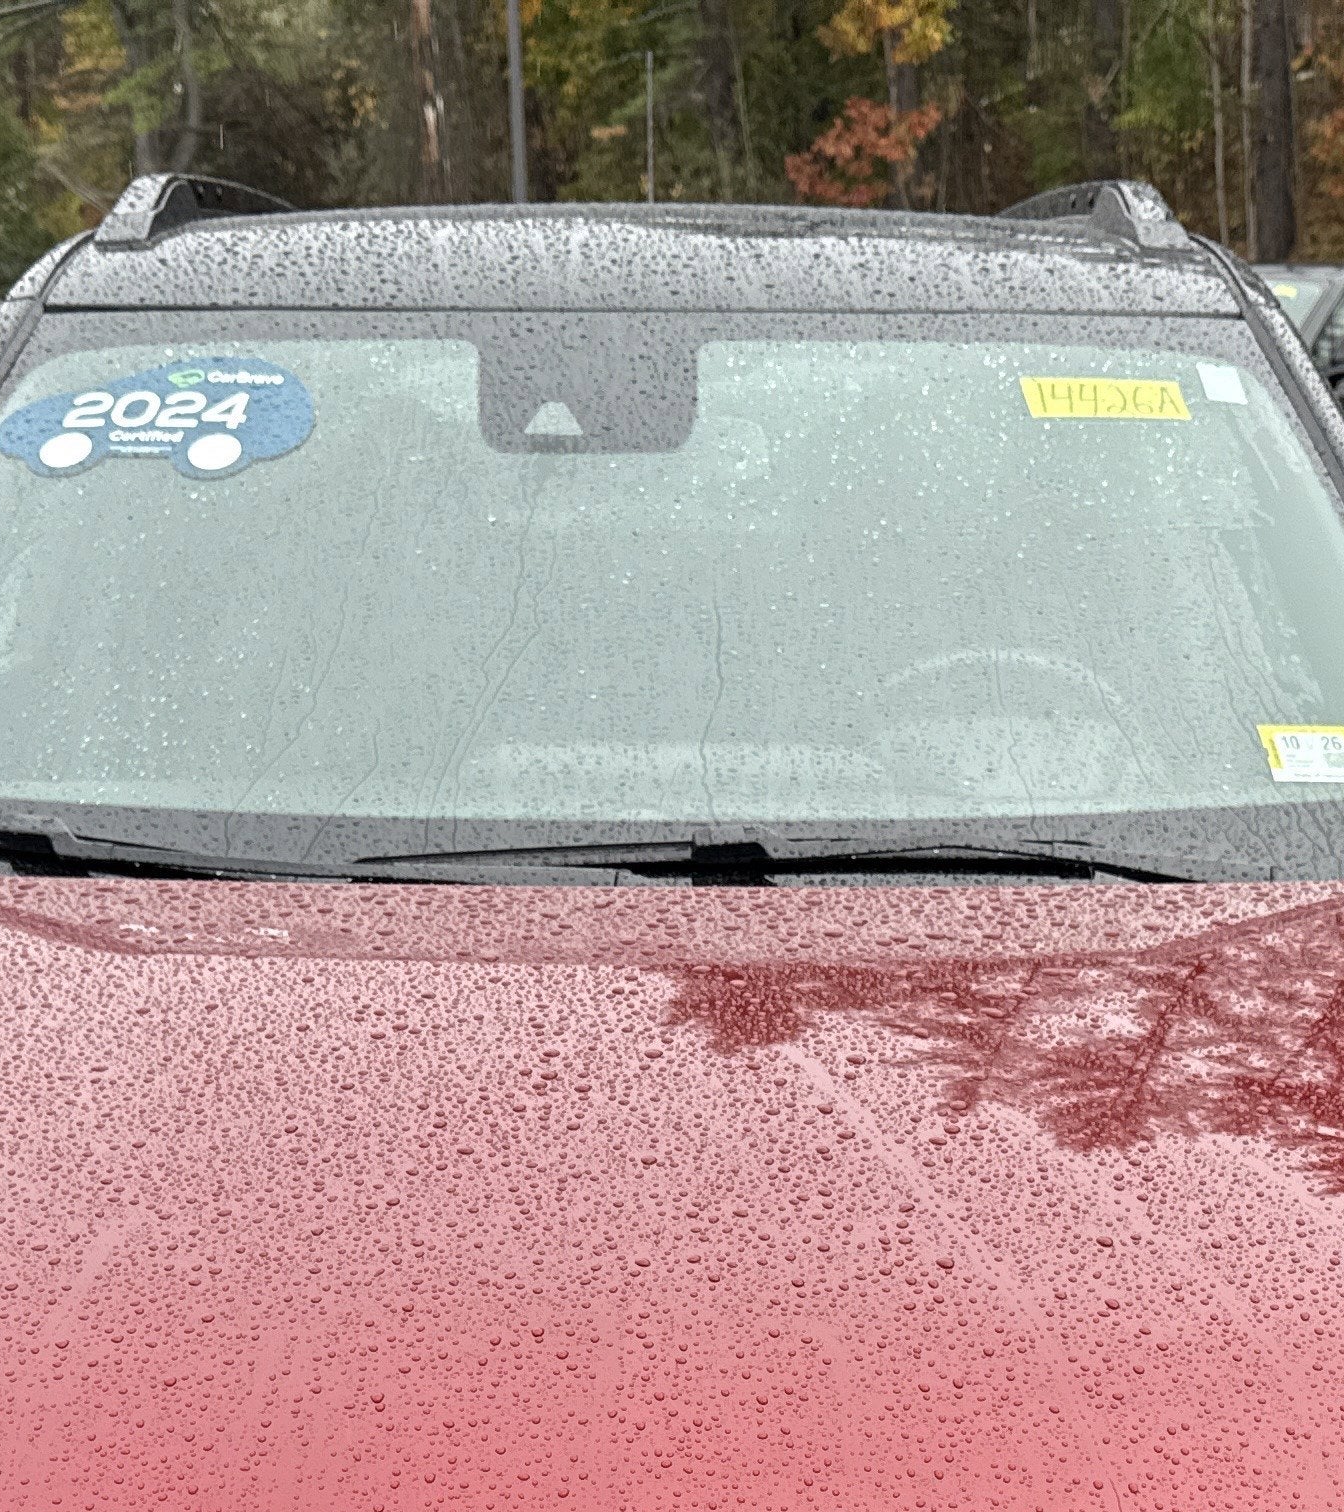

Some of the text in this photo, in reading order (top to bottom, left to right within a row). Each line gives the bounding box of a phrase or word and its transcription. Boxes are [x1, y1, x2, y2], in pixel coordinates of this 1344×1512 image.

[62, 389, 250, 430] 2024
[1281, 735, 1343, 751] 10 26
